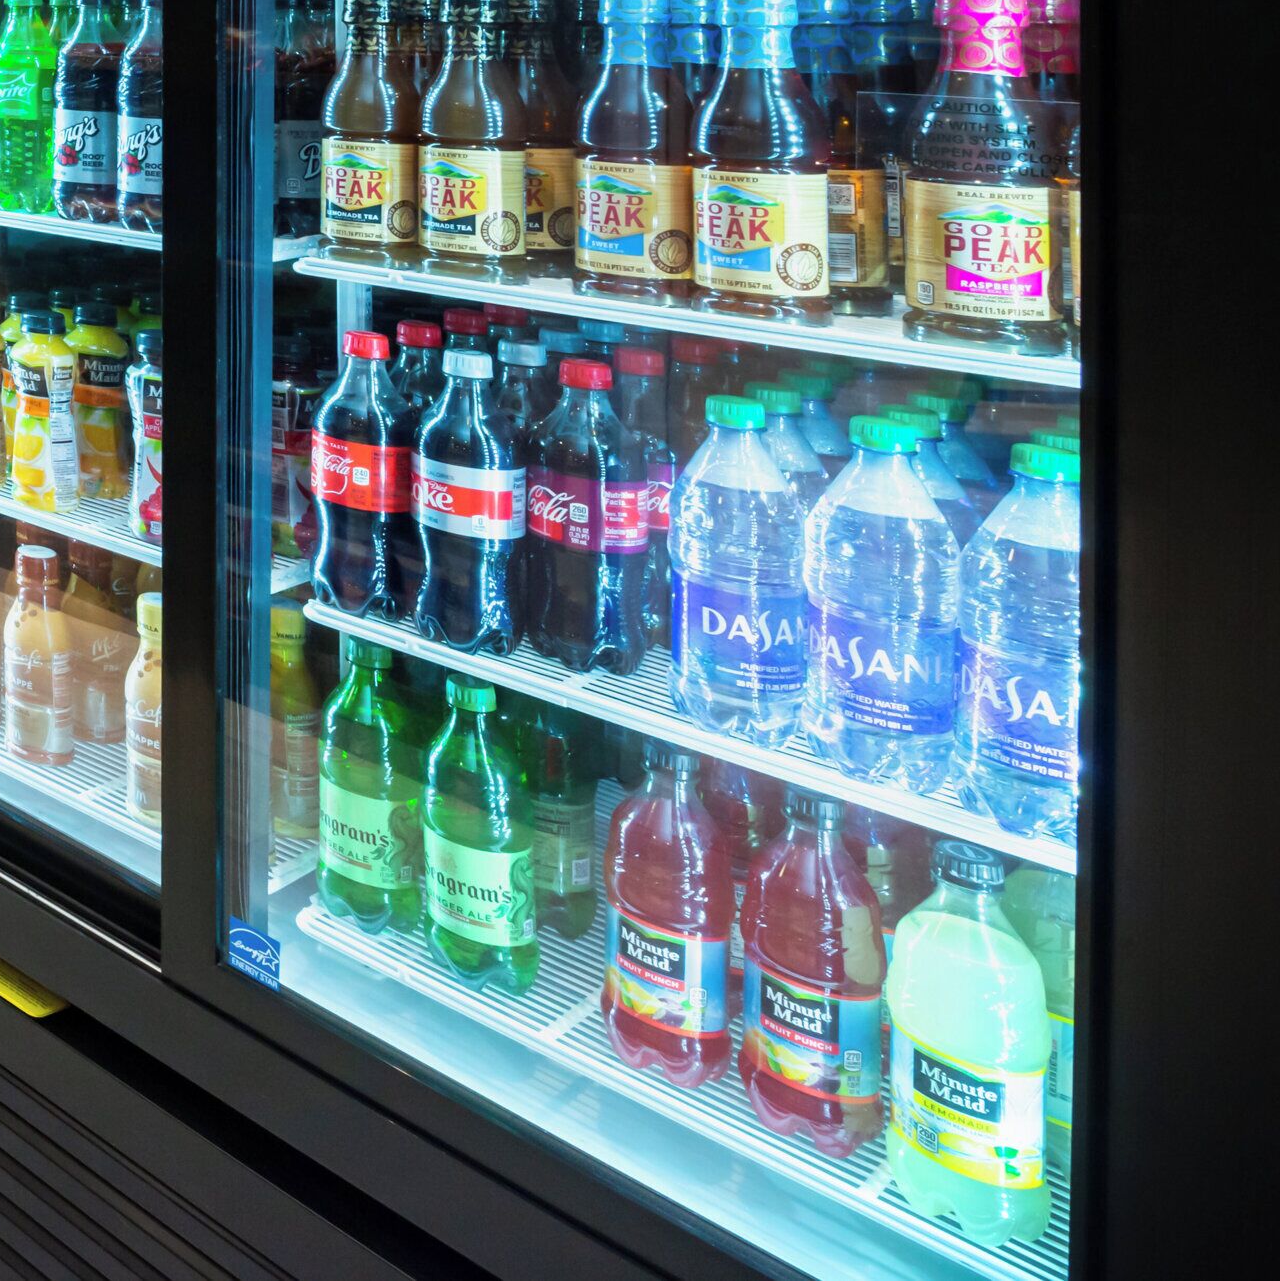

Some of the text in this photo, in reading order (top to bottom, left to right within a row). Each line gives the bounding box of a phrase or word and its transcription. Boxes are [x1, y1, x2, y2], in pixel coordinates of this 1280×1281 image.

[931, 101, 1003, 114] CAUTION
[949, 120, 990, 132] WITH
[82, 153, 106, 161] ROOT
[929, 146, 1076, 166] OPEN AND CLOSE
[82, 160, 104, 168] BEER
[598, 165, 635, 174] BREWED
[325, 167, 382, 181] GOLD
[719, 175, 759, 184] BREWED
[325, 177, 383, 201] PEAK
[420, 175, 477, 190] GOLD
[336, 196, 363, 207] TEA
[419, 184, 478, 210] PEAK
[577, 190, 645, 206] GOLD
[956, 190, 1034, 201] REAL BREWED
[364, 213, 379, 221] TEA
[431, 206, 456, 217] TEA
[577, 200, 646, 229] PEAK
[696, 201, 770, 219] GOLD
[457, 224, 473, 232] TEA
[590, 223, 621, 235] TEA
[696, 213, 772, 243] PEAK
[943, 221, 1043, 238] GOLD
[592, 240, 620, 250] SWEET
[710, 238, 745, 250] TEA
[944, 236, 1045, 265] PEAK
[712, 255, 744, 265] SWEET
[971, 262, 1020, 275] TEA
[960, 278, 1033, 293] RASPBERRY
[943, 301, 960, 311] 18.5
[962, 303, 971, 312] FL
[972, 304, 983, 313] OZ
[1022, 309, 1035, 318] 547
[89, 369, 120, 383] Maid
[329, 442, 349, 451] TASTE
[354, 468, 368, 478] 240
[428, 480, 448, 492] Diet
[412, 481, 456, 512] oke
[572, 505, 587, 515] 260
[874, 699, 910, 713] WATER
[345, 850, 370, 864] ALE
[466, 909, 493, 923] ALE
[620, 925, 681, 963] Minute
[627, 941, 672, 973] Maid
[231, 956, 279, 990] ENERGY STAR
[618, 956, 680, 990] FRUIT PUNCH
[766, 987, 833, 1024] Minute
[773, 1003, 824, 1034] Maid
[763, 1018, 834, 1053] FRUIT PUNCH
[920, 1059, 998, 1103] Minute
[929, 1078, 990, 1115] Maid
[918, 1125, 937, 1143] 260
